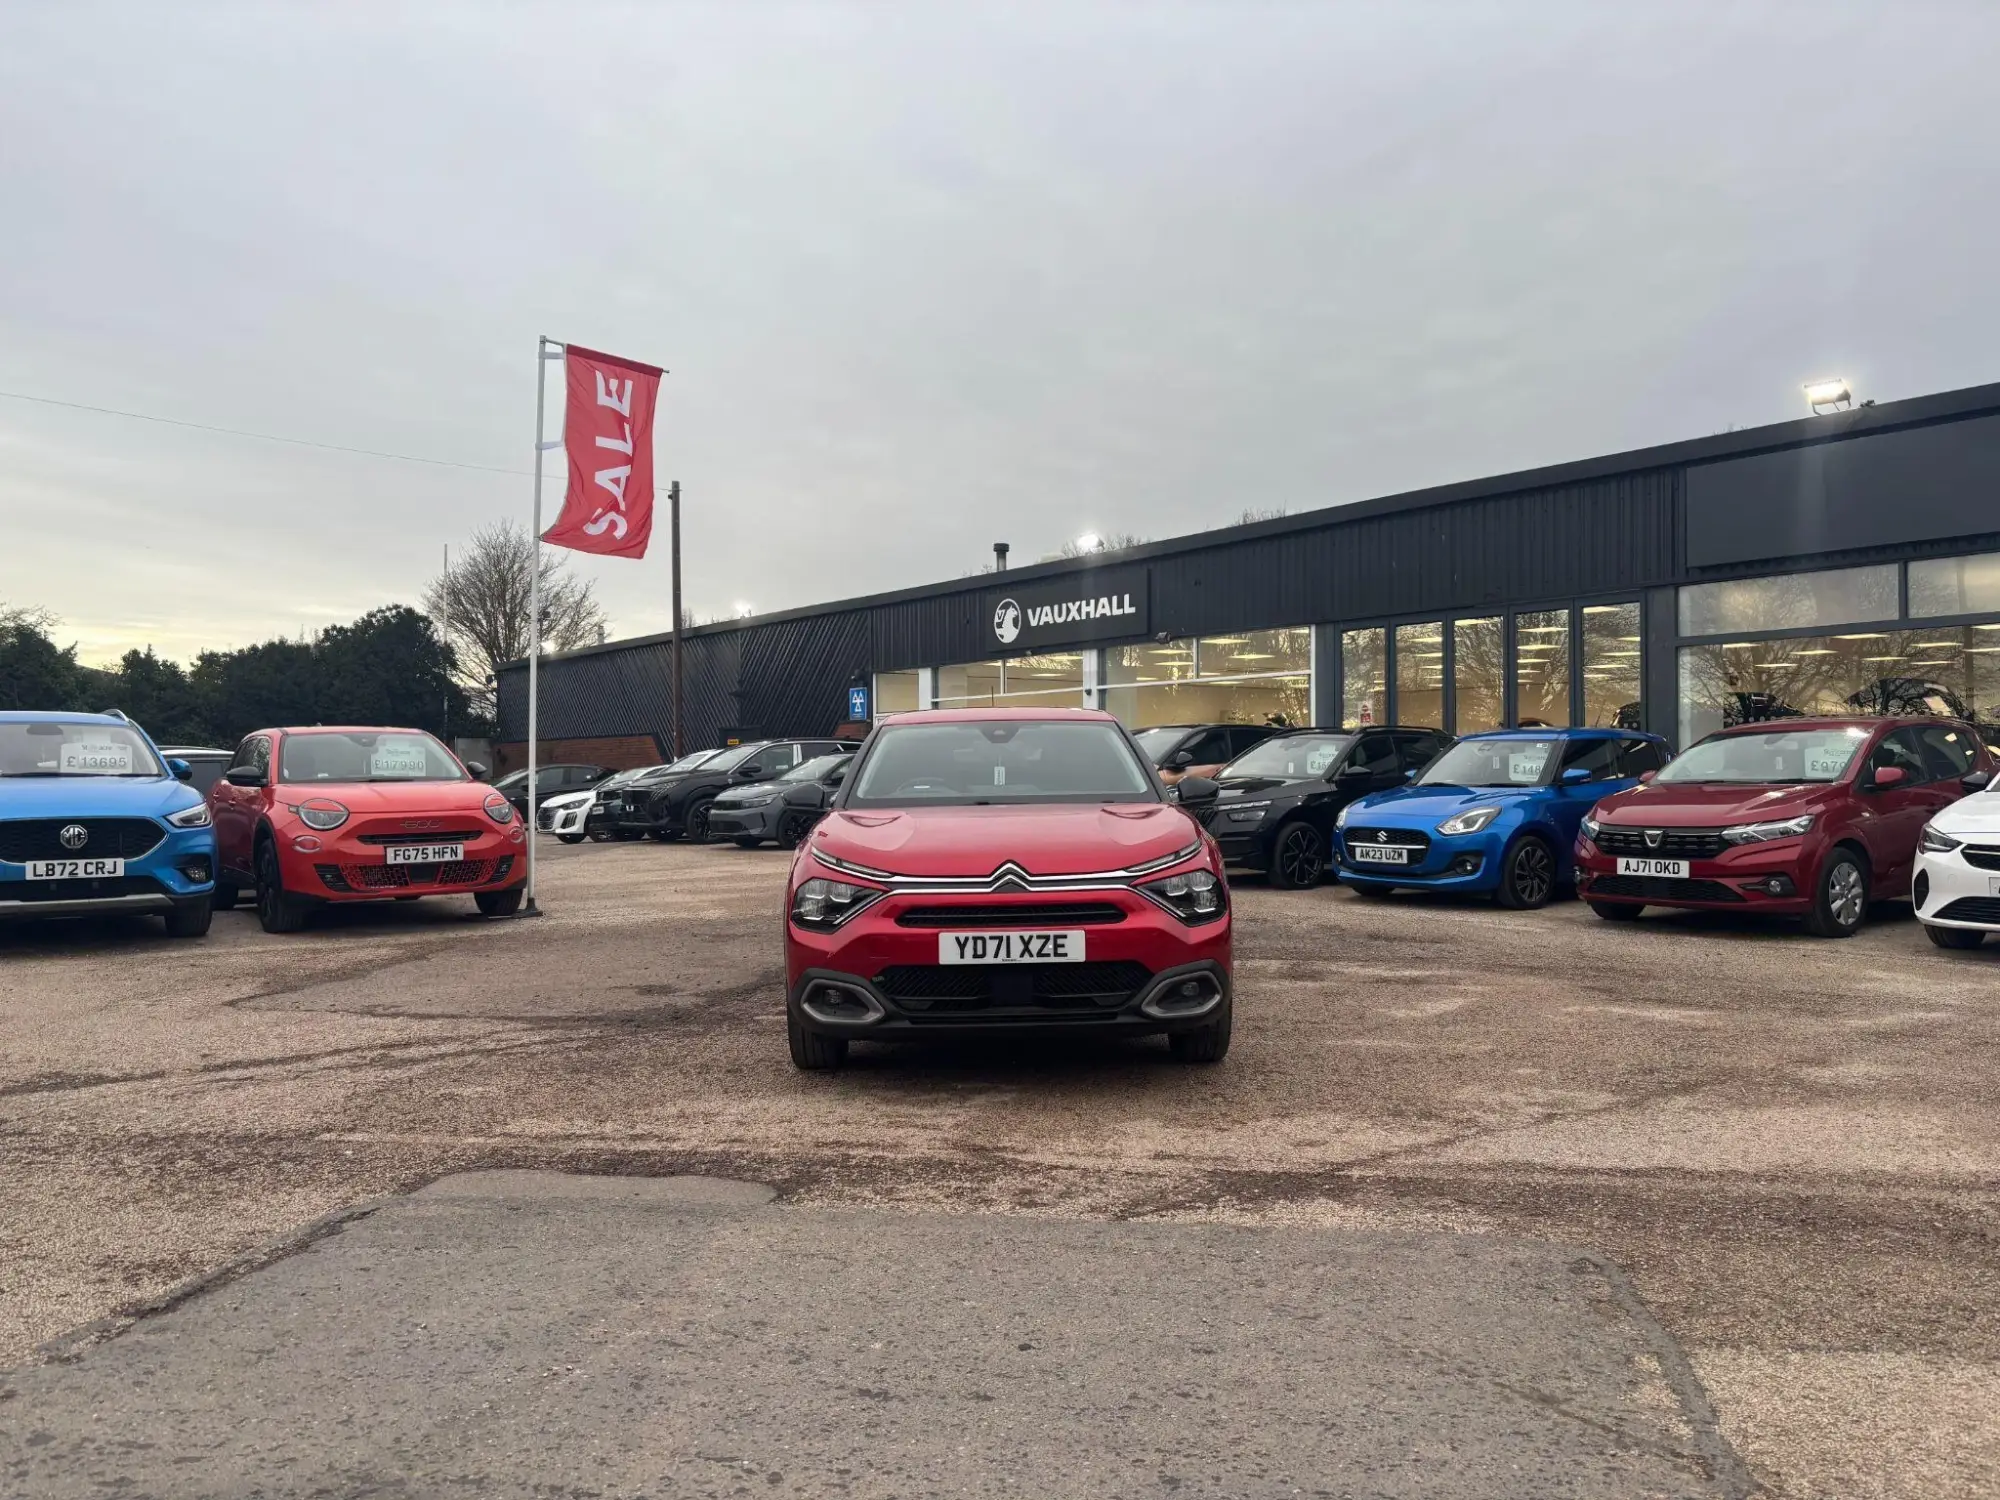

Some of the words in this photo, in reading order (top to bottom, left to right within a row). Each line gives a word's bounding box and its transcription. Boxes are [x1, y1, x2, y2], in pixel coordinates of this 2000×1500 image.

[583, 370, 633, 540] SALE
[1027, 593, 1136, 627] VAUXHALL
[62, 825, 87, 847] MG
[394, 847, 429, 861] FG75
[433, 846, 458, 859] HFN
[1360, 849, 1383, 860] AK23
[33, 862, 79, 878] LB72
[84, 861, 117, 876] CRJ
[1624, 860, 1651, 873] AJ71
[1655, 861, 1680, 875] OKD
[954, 935, 1011, 959] YD71
[1019, 934, 1068, 958] XZE
